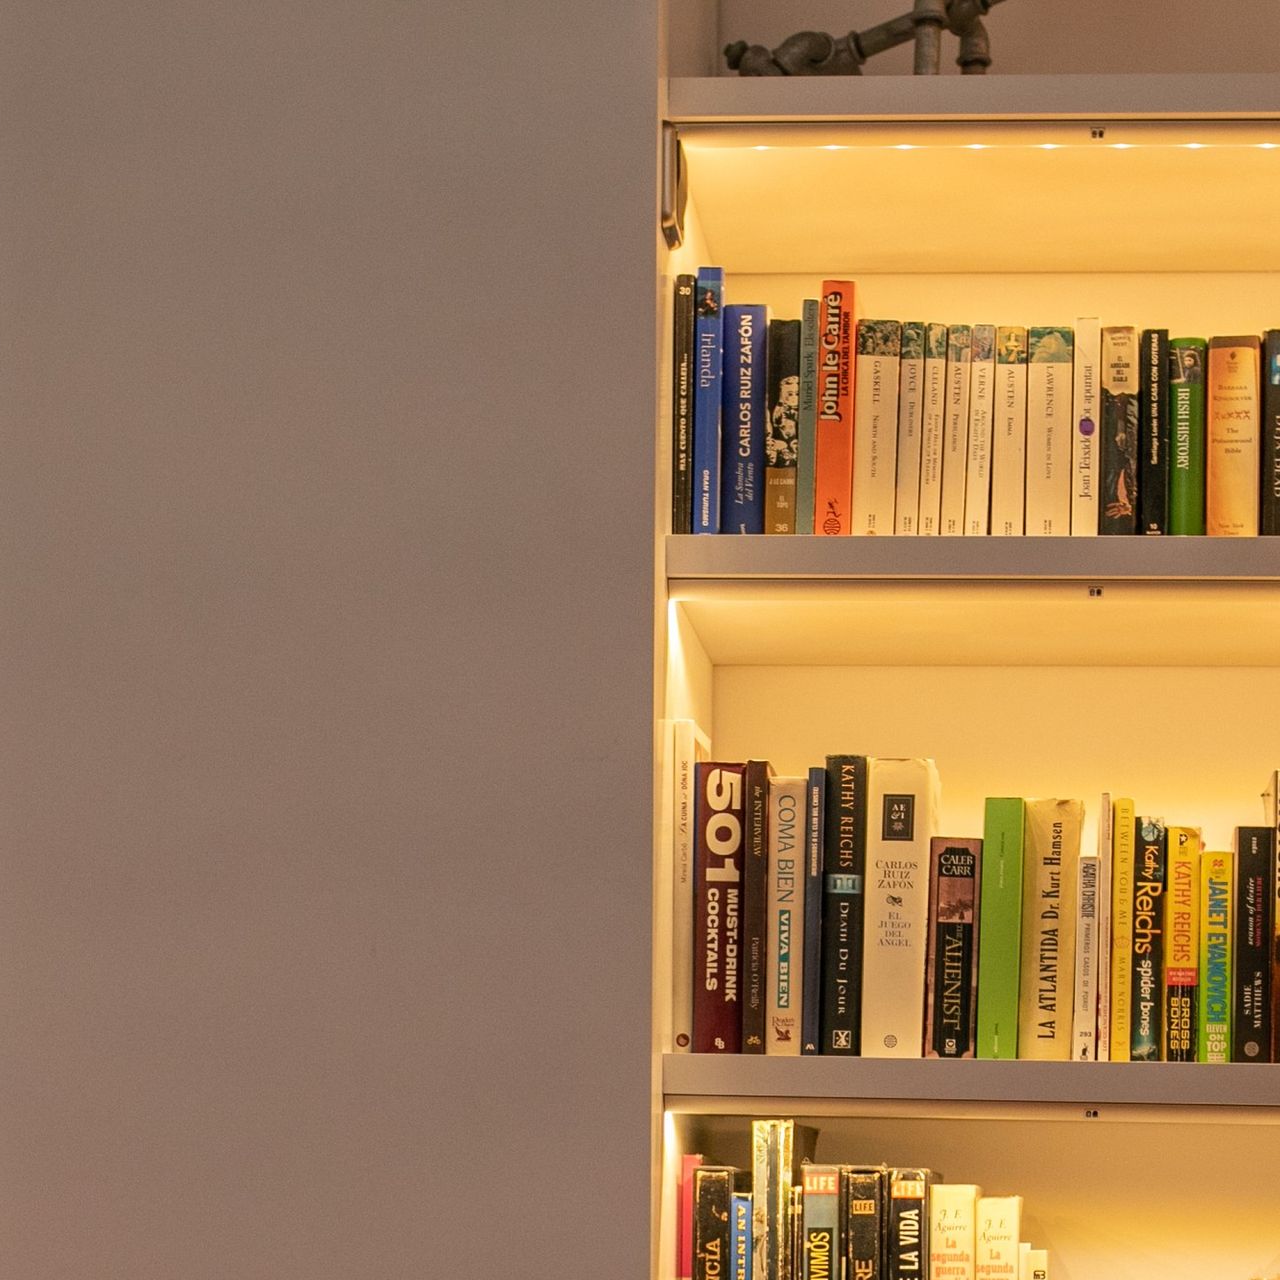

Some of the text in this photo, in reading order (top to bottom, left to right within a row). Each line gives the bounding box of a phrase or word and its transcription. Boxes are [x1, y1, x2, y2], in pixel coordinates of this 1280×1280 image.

[679, 286, 691, 295] 30
[700, 333, 716, 388] Irlanda
[820, 290, 842, 422] John le Carré
[907, 363, 917, 393] JOYCE
[1150, 333, 1160, 417] UNA CASA CON GOTERAS
[738, 314, 753, 457] CARLOS RUIZ ZAFÓN
[872, 360, 881, 405] GASKELL
[952, 366, 961, 406] AUSTEN
[1006, 369, 1016, 408] AUSTEN
[1045, 366, 1055, 418] LAWRENCE
[1176, 388, 1190, 470] IRISH HISTORY
[702, 469, 710, 527] GRAN TURISMO
[735, 463, 744, 505] La Sombra
[745, 463, 755, 502] del Viento
[705, 768, 742, 882] 501
[752, 785, 763, 857] the INTERVIEW
[839, 764, 855, 867] KATHY REICHS
[776, 794, 797, 903] COMA BIEN
[875, 859, 919, 869] CARLOS
[941, 865, 971, 876] CARR
[1040, 821, 1063, 920] Dr. Kurt Hamsen
[883, 871, 911, 880] RUIZ
[1174, 860, 1192, 910] KATHY
[888, 911, 902, 920] EL
[1135, 845, 1163, 955] Kathy Reichs
[705, 888, 720, 991] COCKTAILS
[724, 888, 739, 1002] MUST-DRINK
[878, 921, 911, 929] JUEGO
[1173, 912, 1191, 963] REICHS
[778, 912, 790, 1007] VIVA BIEN
[1206, 877, 1229, 1023] JANET EVANOVICH
[1037, 928, 1059, 1039] LA ATLANTIDA
[1136, 959, 1156, 1037] spider bones
[1243, 984, 1252, 1016] SADIE
[1253, 971, 1263, 1029] MATTHEWS
[1170, 997, 1180, 1050] BONES
[1181, 997, 1191, 1050] CROSS
[1206, 1023, 1228, 1033] ELEVEN
[1206, 1041, 1227, 1052] TOP
[805, 1176, 836, 1191] LIFE
[736, 1205, 746, 1231] AN
[854, 1201, 874, 1212] LIFE
[899, 1208, 920, 1246] VIDA
[899, 1250, 919, 1270] LA
[931, 1251, 970, 1265] segunda
[945, 1237, 957, 1249] La
[989, 1248, 1001, 1260] La
[935, 1265, 966, 1277] guerra
[976, 1263, 1014, 1275] segunda
